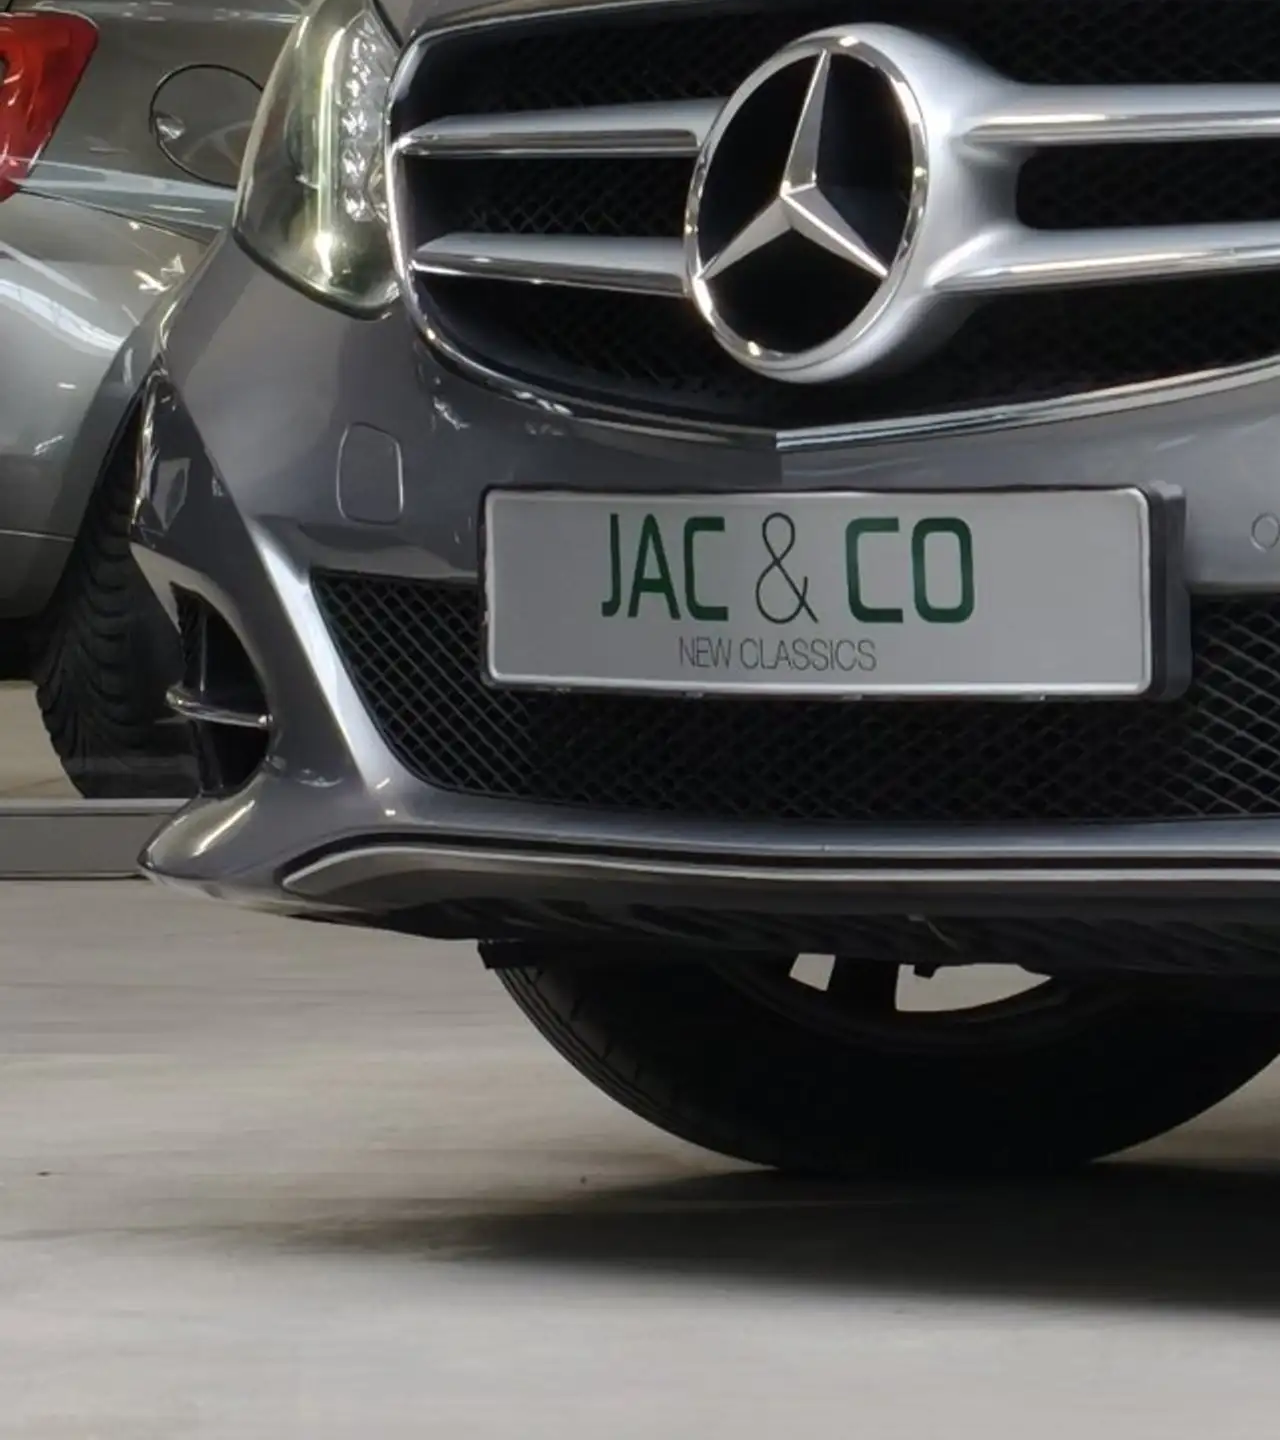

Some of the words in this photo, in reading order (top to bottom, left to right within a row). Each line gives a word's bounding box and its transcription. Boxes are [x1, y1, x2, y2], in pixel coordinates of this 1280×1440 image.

[601, 513, 729, 621] JAC
[755, 512, 819, 624] &
[844, 517, 975, 624] CO
[678, 636, 733, 670] NEW
[739, 637, 877, 672] CLASSICS
